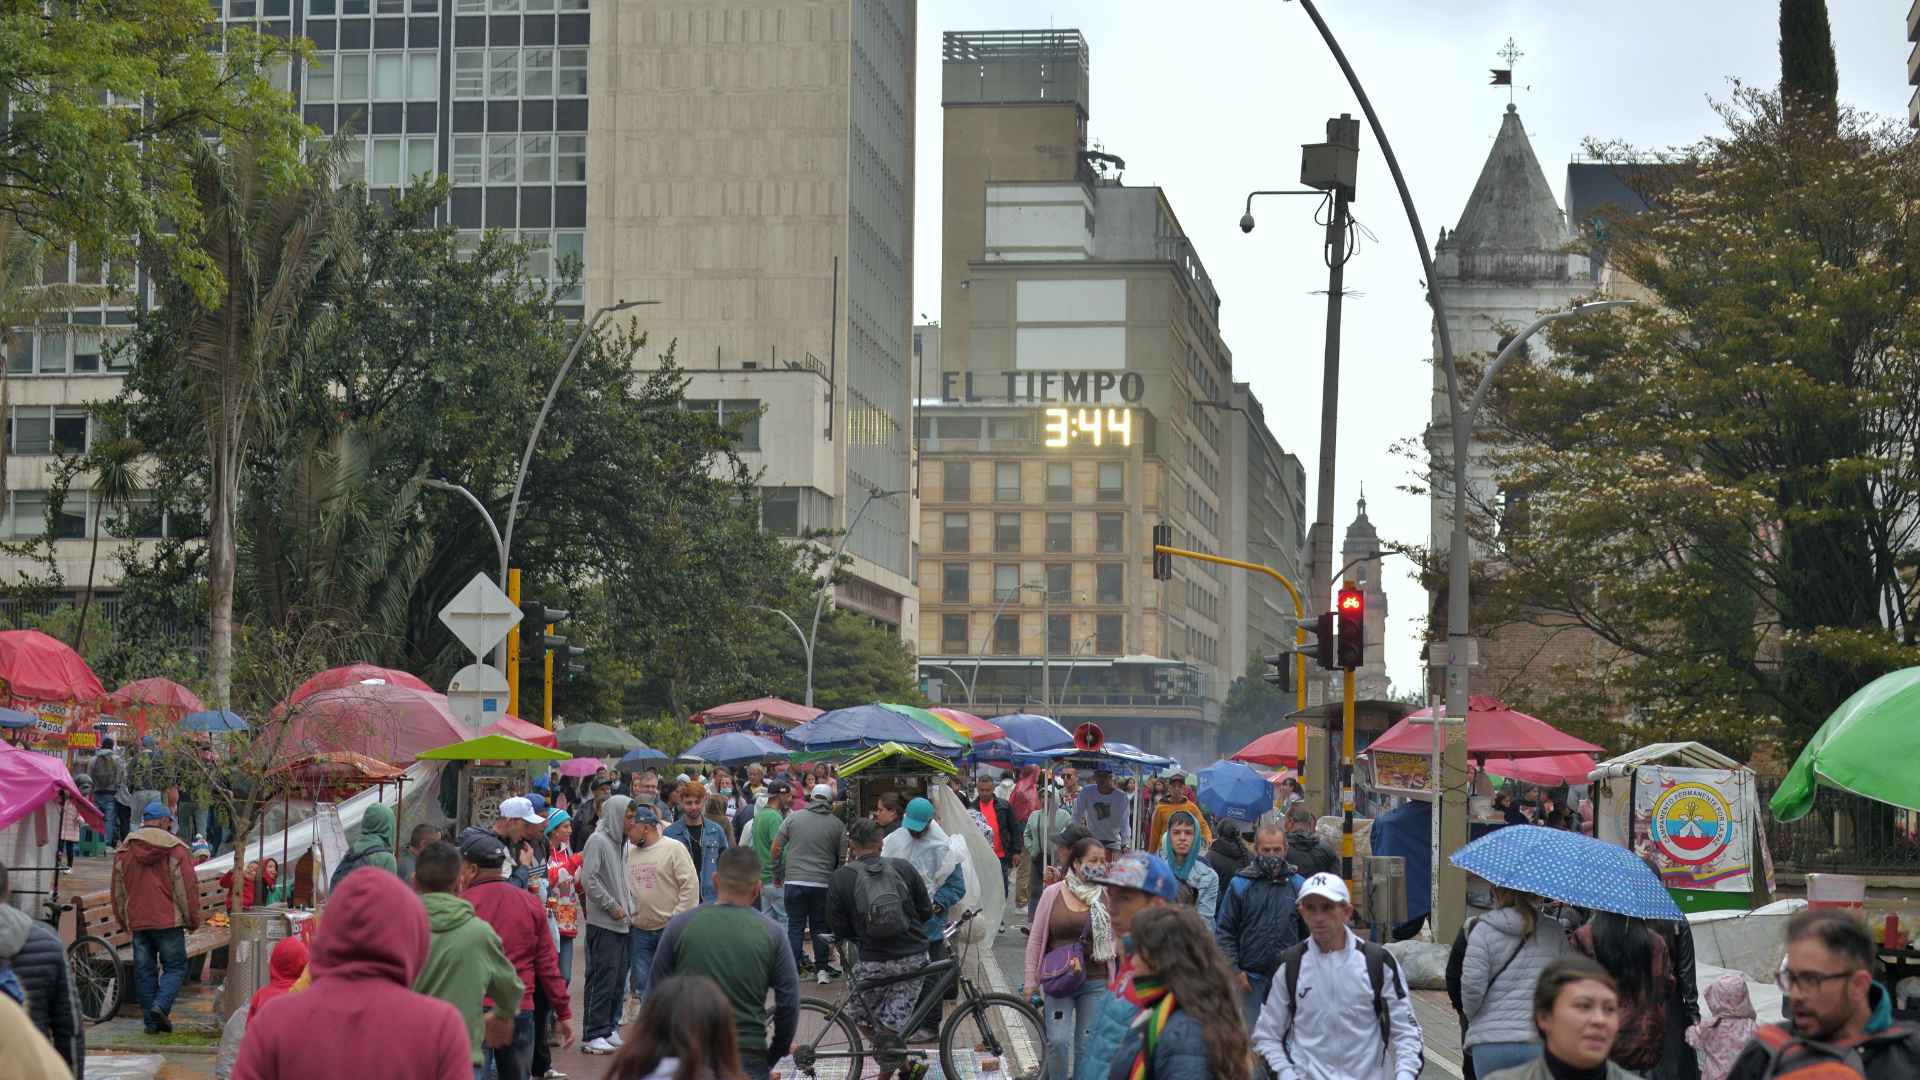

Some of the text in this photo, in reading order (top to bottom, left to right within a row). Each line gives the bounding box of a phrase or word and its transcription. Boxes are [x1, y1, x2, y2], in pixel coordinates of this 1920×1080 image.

[942, 371, 1145, 402] EL TIEMPO
[1045, 408, 1131, 447] 3:44
